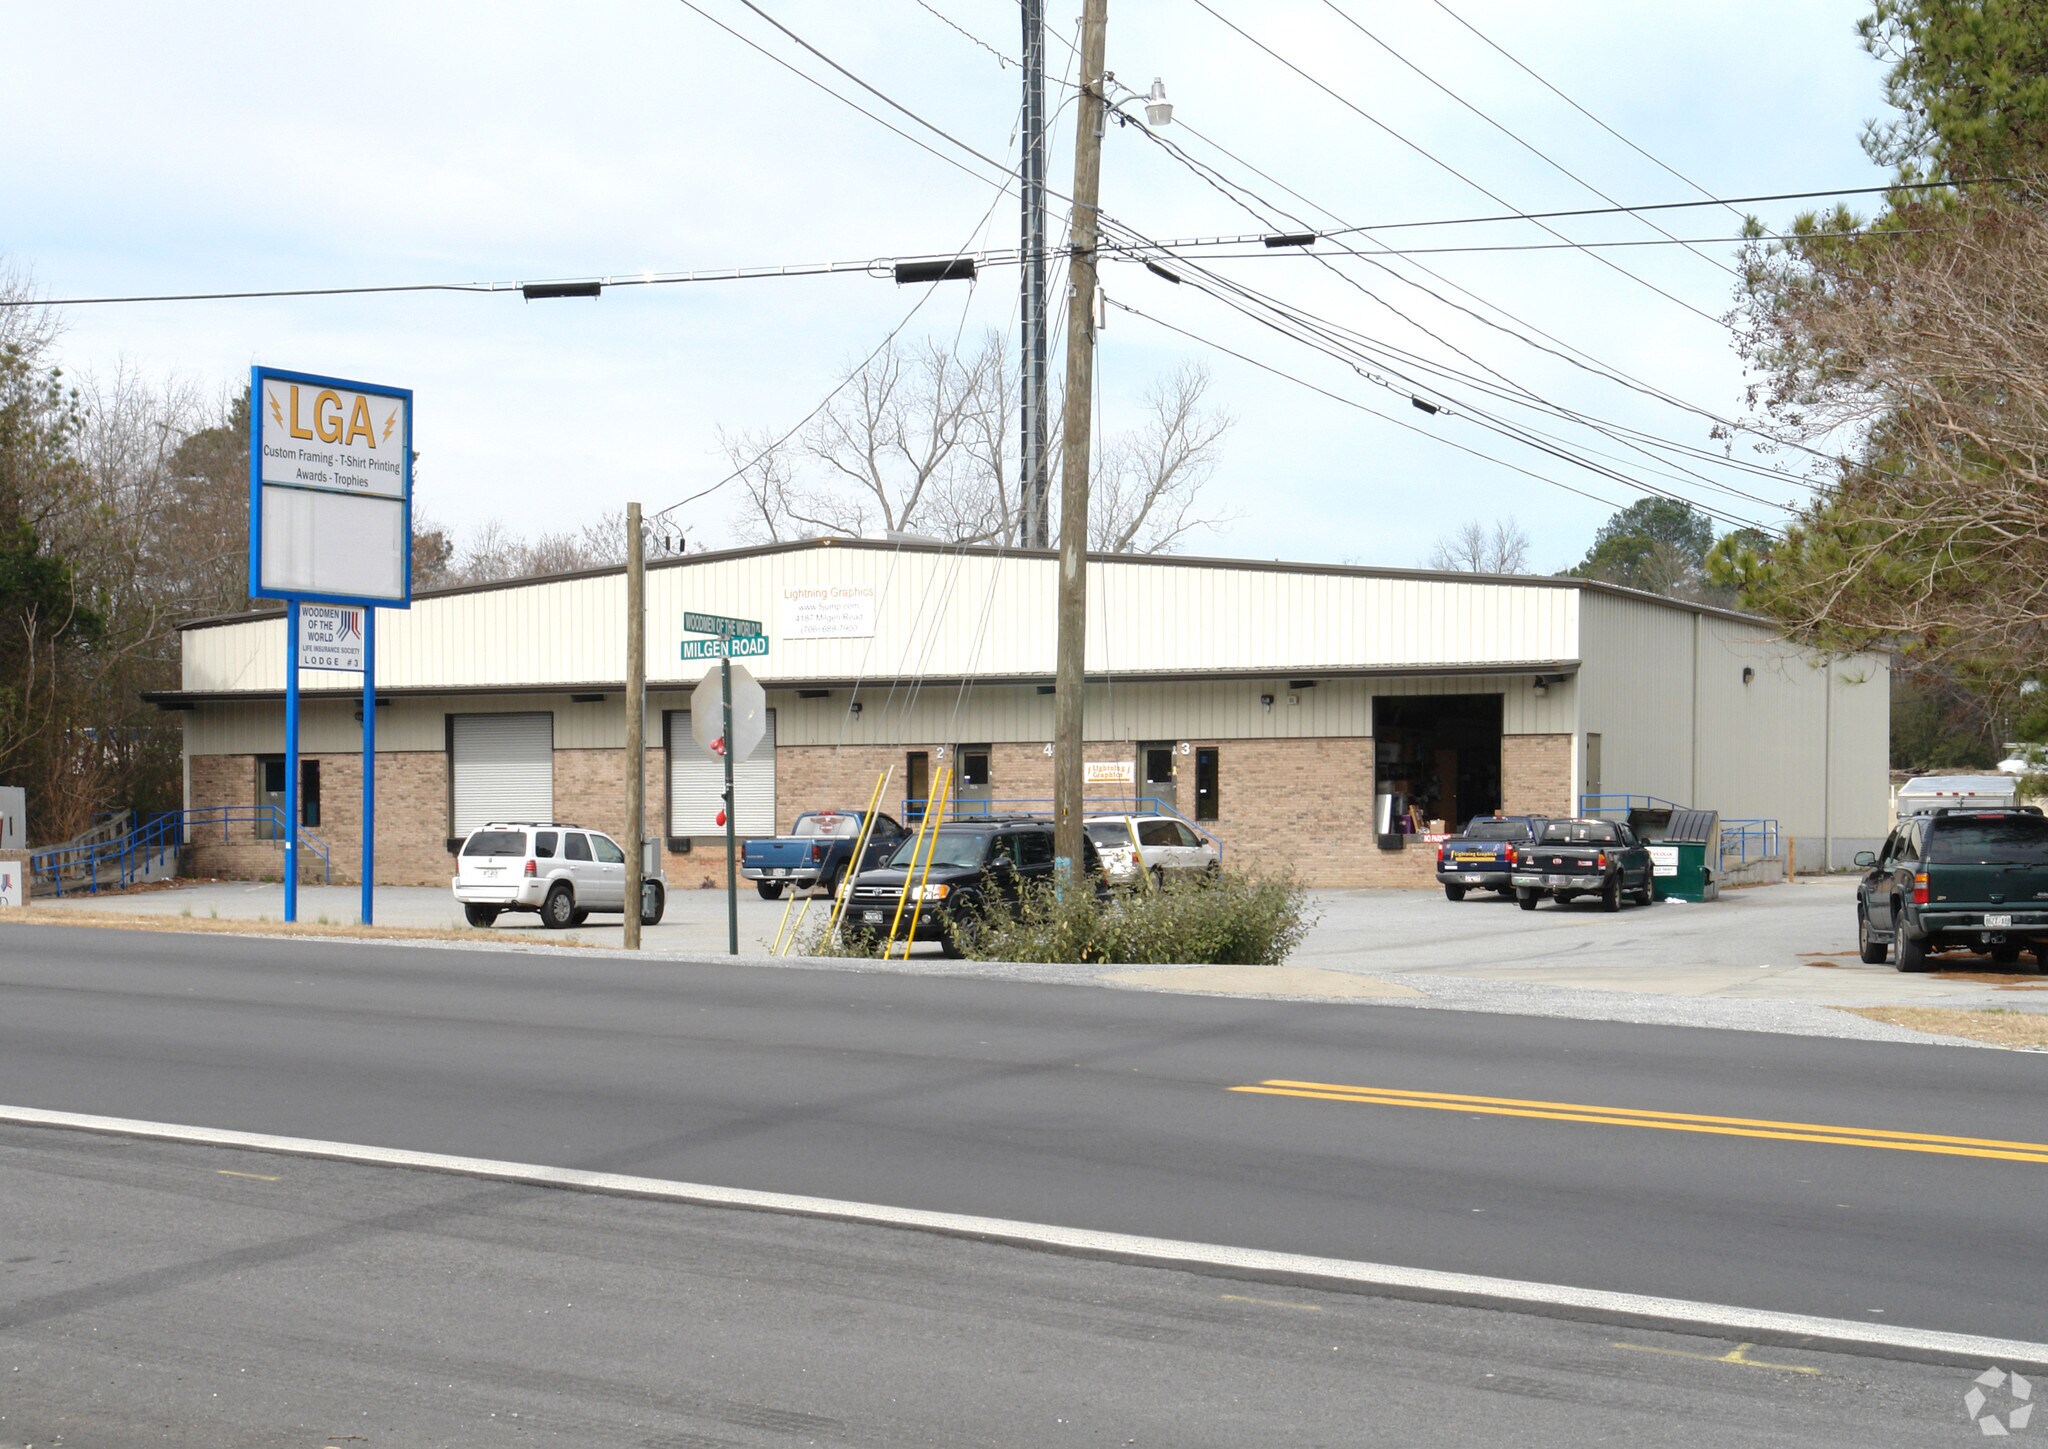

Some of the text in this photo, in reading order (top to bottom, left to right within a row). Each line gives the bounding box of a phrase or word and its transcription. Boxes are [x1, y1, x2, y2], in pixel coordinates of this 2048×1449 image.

[290, 385, 376, 449] LGA
[263, 444, 297, 460] Custom
[299, 449, 334, 467] Framing
[340, 454, 367, 469] T-Shirt
[369, 458, 400, 475] Printing
[296, 468, 328, 482] Awards
[334, 472, 369, 487] Trophies
[784, 587, 874, 601] Lightning Graphics
[302, 607, 339, 618] WOODMEN
[308, 619, 334, 630] OF THE
[685, 613, 715, 633] WOODMEN
[716, 617, 725, 634] OF
[725, 619, 736, 636] THE
[736, 621, 756, 637] WORLD
[307, 632, 334, 642] WORLD
[313, 645, 340, 653] INSURANCE
[683, 638, 766, 658] MILGEN ROAD
[304, 656, 339, 666] LODGE
[936, 747, 944, 759] 2
[1181, 743, 1190, 755] 3
[1092, 764, 1125, 772] Lightning
[1092, 771, 1124, 779] Graphics
[1424, 834, 1431, 842] NO
